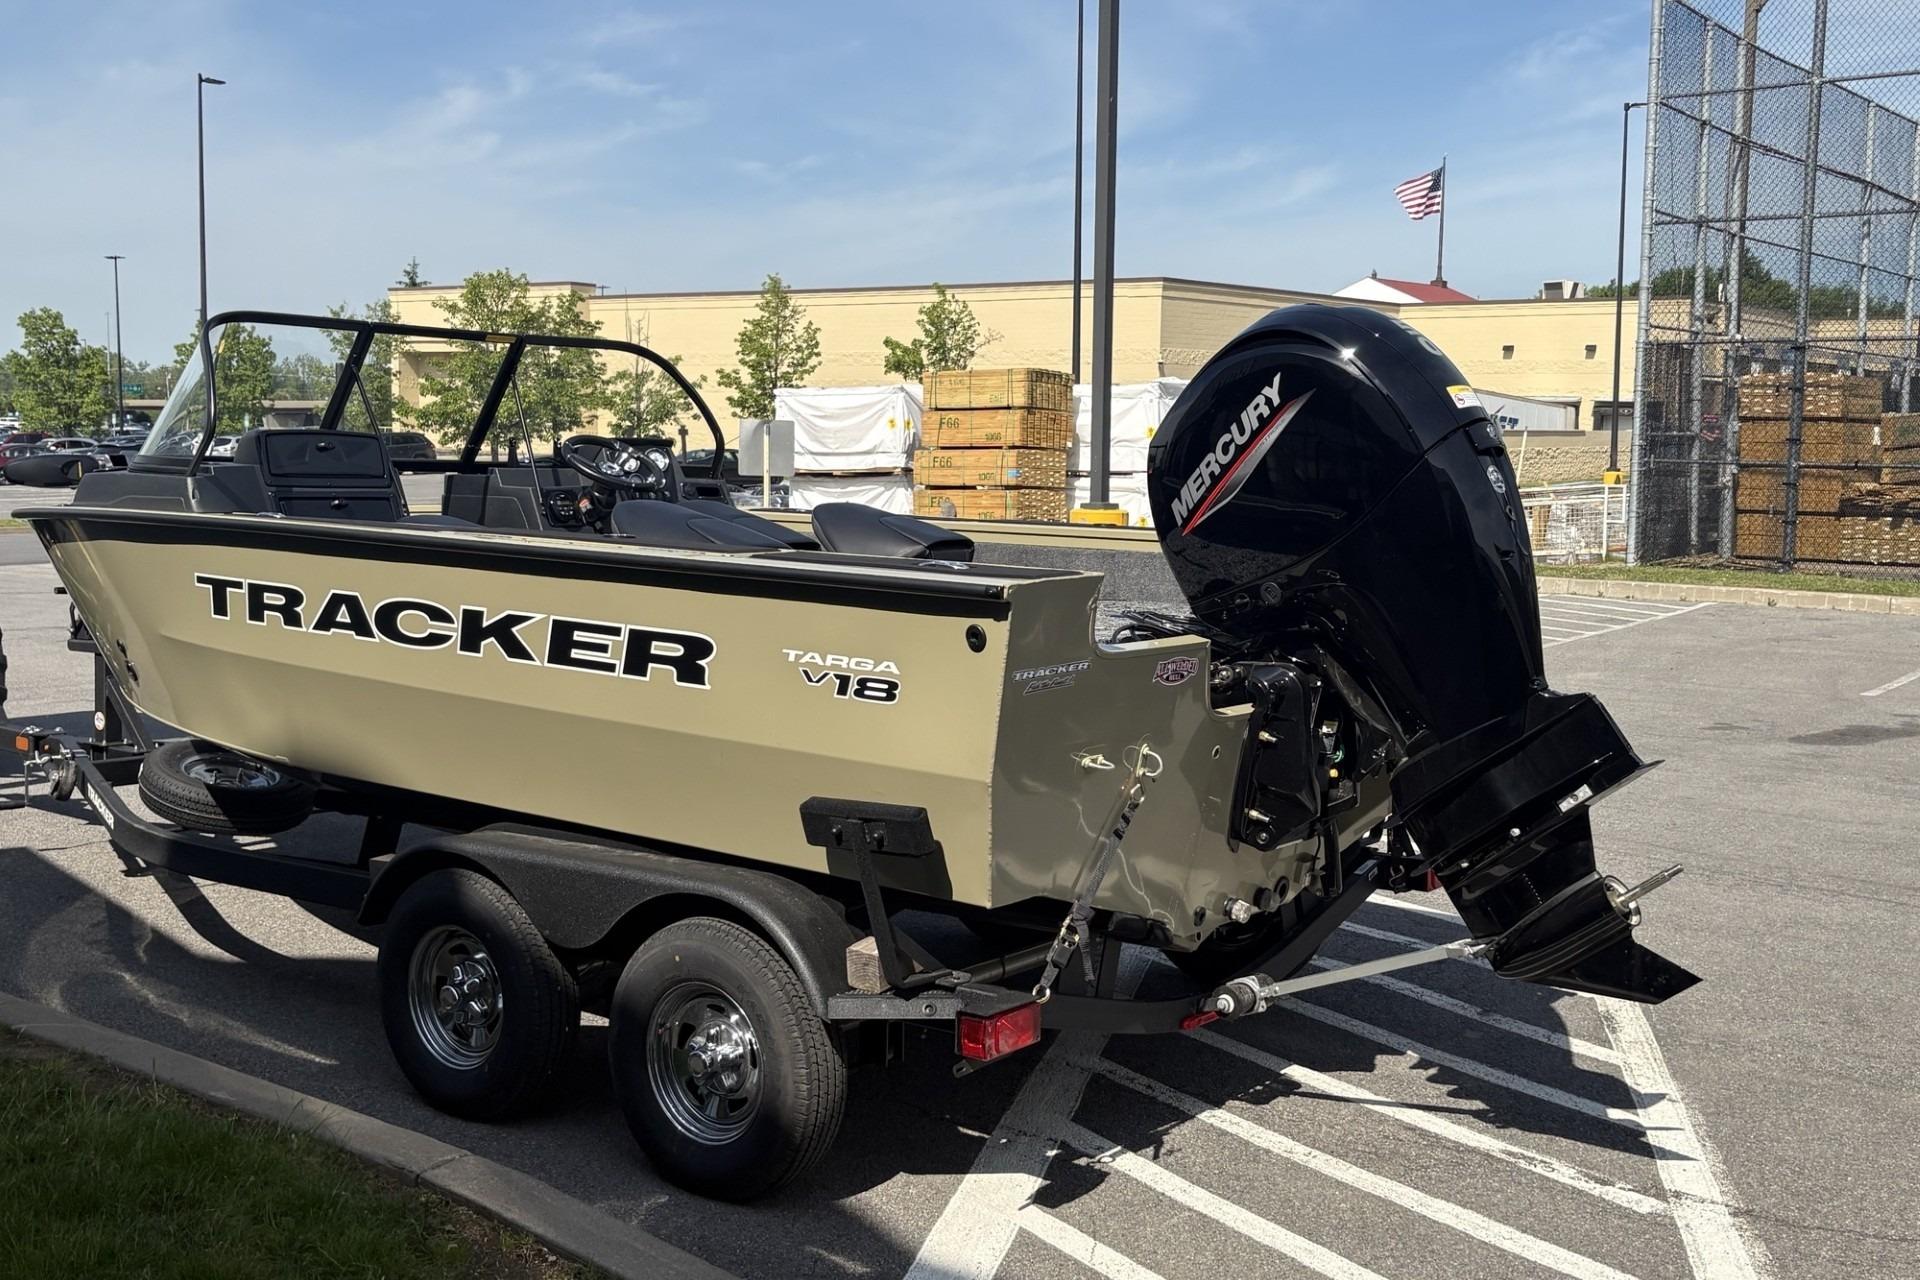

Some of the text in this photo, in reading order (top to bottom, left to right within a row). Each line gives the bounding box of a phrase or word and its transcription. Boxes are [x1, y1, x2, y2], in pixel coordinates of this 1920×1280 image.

[939, 416, 960, 429] F66
[932, 455, 953, 468] F66
[1170, 371, 1281, 527] MERCURY
[194, 572, 717, 690] TRACKER
[781, 648, 901, 675] TARGA
[1012, 660, 1090, 682] TRACKER
[798, 666, 901, 705] V18
[86, 782, 115, 830] TRACKER
